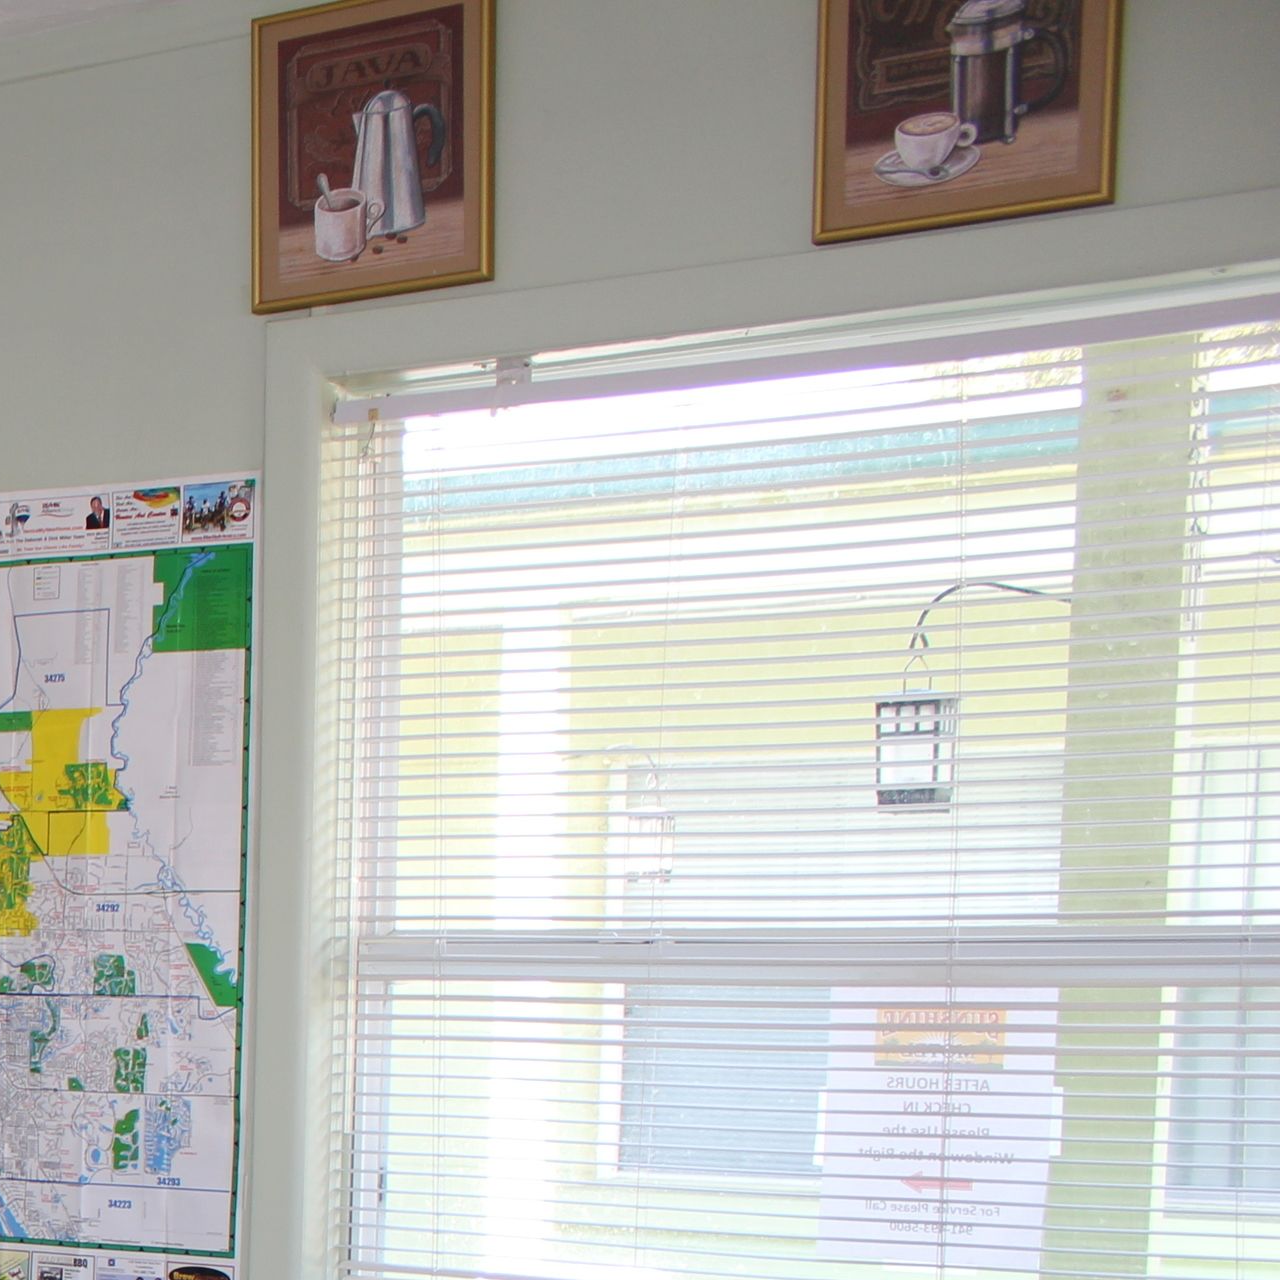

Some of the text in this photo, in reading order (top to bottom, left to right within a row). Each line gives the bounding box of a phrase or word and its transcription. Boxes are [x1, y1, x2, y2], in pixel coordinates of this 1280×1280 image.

[315, 50, 422, 88] JAVA
[44, 673, 66, 684] 34275
[95, 902, 120, 914] 34292
[156, 1176, 181, 1187] 34293
[107, 1198, 132, 1210] 34223
